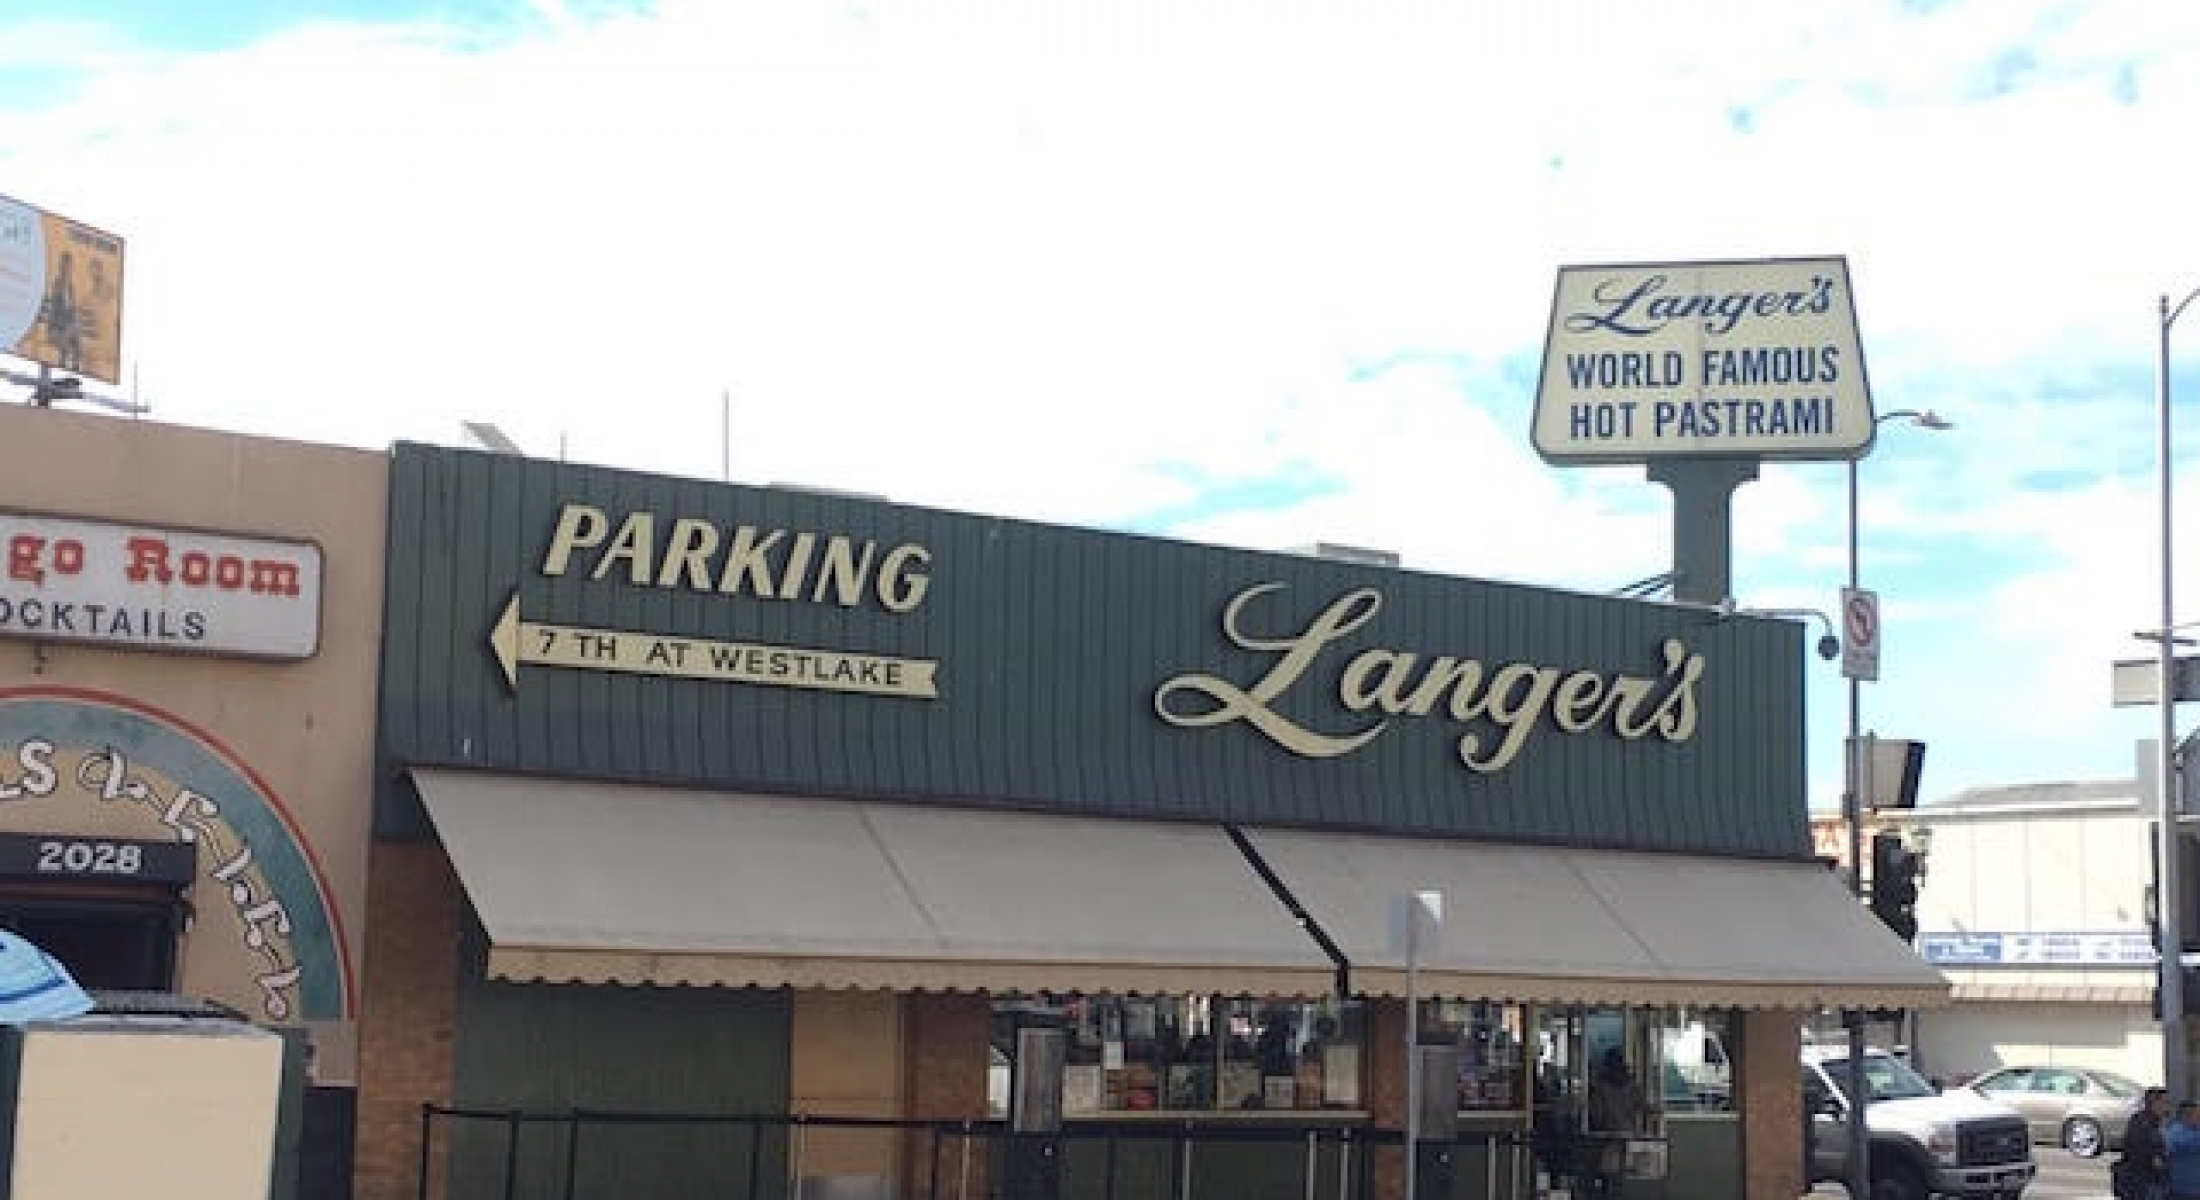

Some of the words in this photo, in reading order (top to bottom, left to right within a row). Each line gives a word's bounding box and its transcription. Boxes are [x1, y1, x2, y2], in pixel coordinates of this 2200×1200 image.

[1564, 275, 1833, 336] Langer's
[1566, 351, 1682, 389] WORLD
[1703, 346, 1839, 386] FAMOUS
[1570, 402, 1637, 438] HOT
[1655, 398, 1834, 437] PASTRAMI
[127, 538, 299, 596] Room
[543, 504, 931, 612] PARKING
[539, 630, 555, 655] 7
[573, 635, 616, 660] TH
[646, 642, 692, 666] AT
[711, 648, 902, 685] WESTLAKE
[1153, 581, 1706, 772] Langer's
[38, 842, 142, 872] 2028
